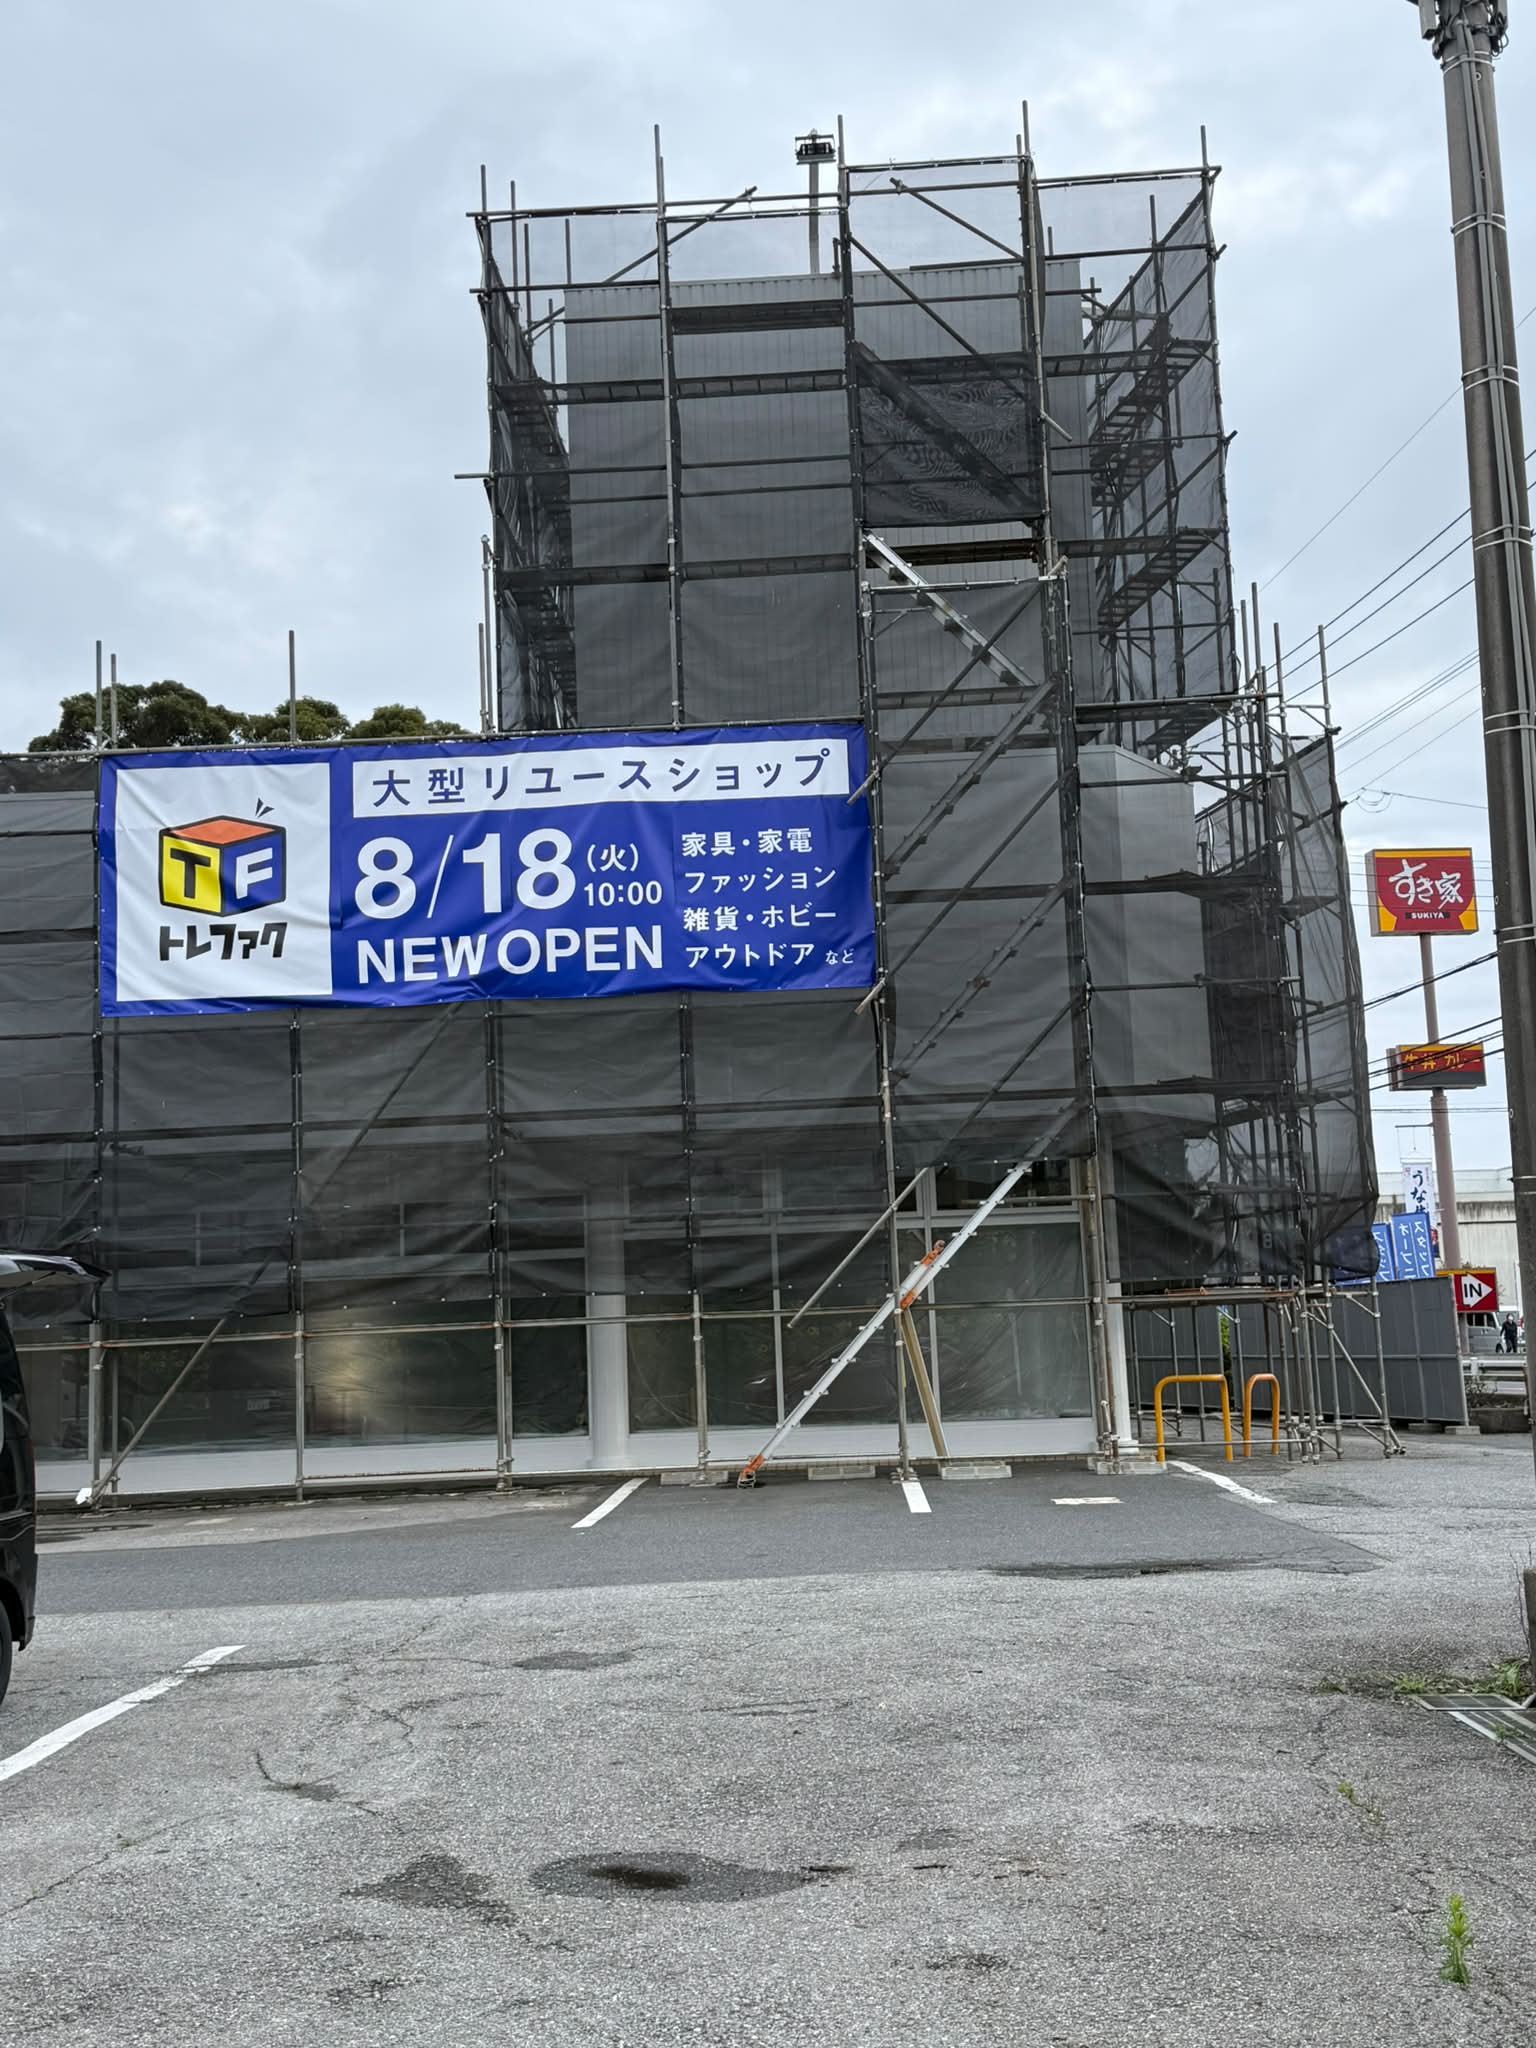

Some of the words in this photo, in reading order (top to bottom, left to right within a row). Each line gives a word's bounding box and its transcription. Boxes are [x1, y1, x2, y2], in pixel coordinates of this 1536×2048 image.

[372, 747, 831, 808] 大型リユースショップ
[681, 827, 813, 858] 家具・家電
[354, 827, 577, 920] 8/18
[586, 843, 640, 874] (火)
[684, 866, 837, 895] ファッション
[1388, 858, 1465, 910] すき家
[583, 880, 663, 907] 10:00
[683, 902, 837, 932] 雑貨・ホビー
[1411, 911, 1445, 920] SUKIYA
[159, 921, 289, 962] トレファク
[357, 932, 487, 985] NEW
[496, 924, 664, 976] OPEN
[684, 942, 815, 970] アウトドア
[825, 949, 855, 966] など
[1463, 1282, 1483, 1298] IN
